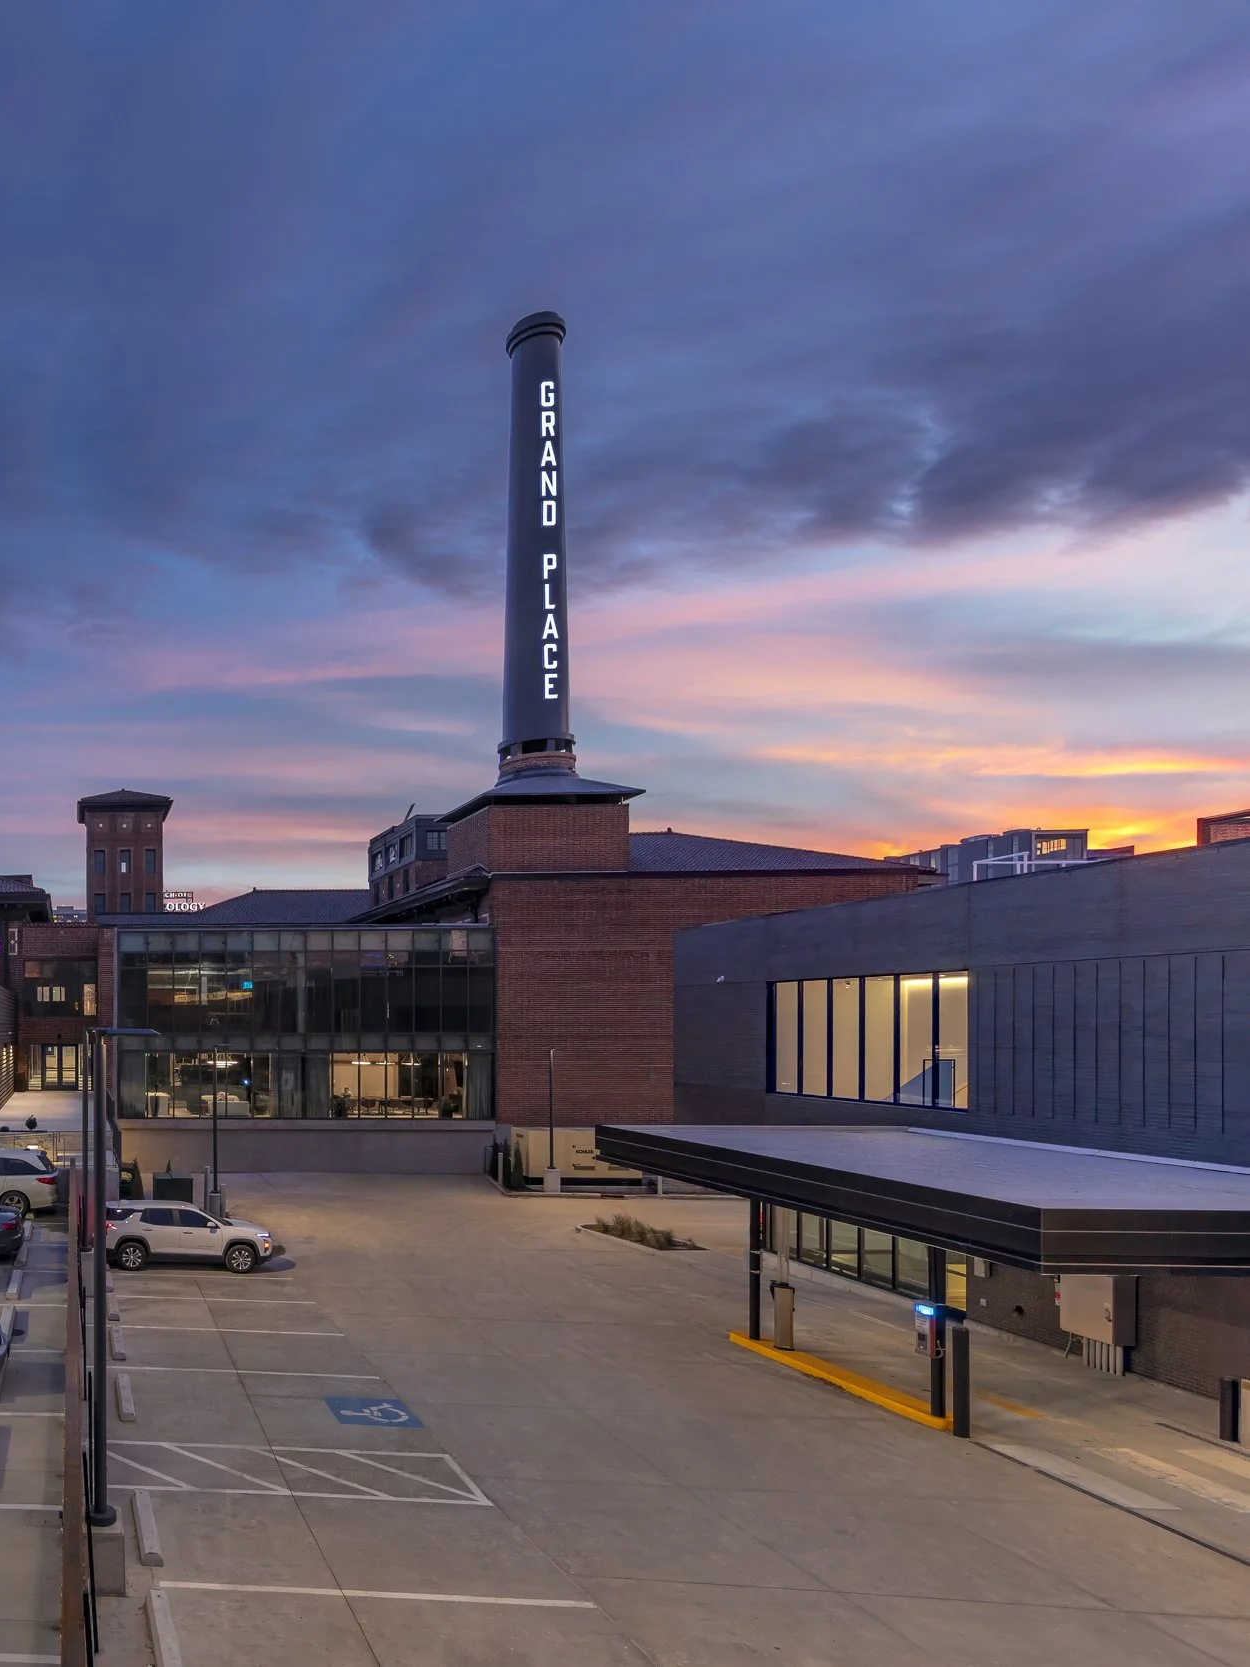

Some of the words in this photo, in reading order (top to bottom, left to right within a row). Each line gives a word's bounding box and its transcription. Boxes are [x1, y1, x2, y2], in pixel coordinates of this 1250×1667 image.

[540, 380, 557, 526] GRAND
[542, 553, 559, 700] PLACE
[164, 902, 206, 911] OLOGY
